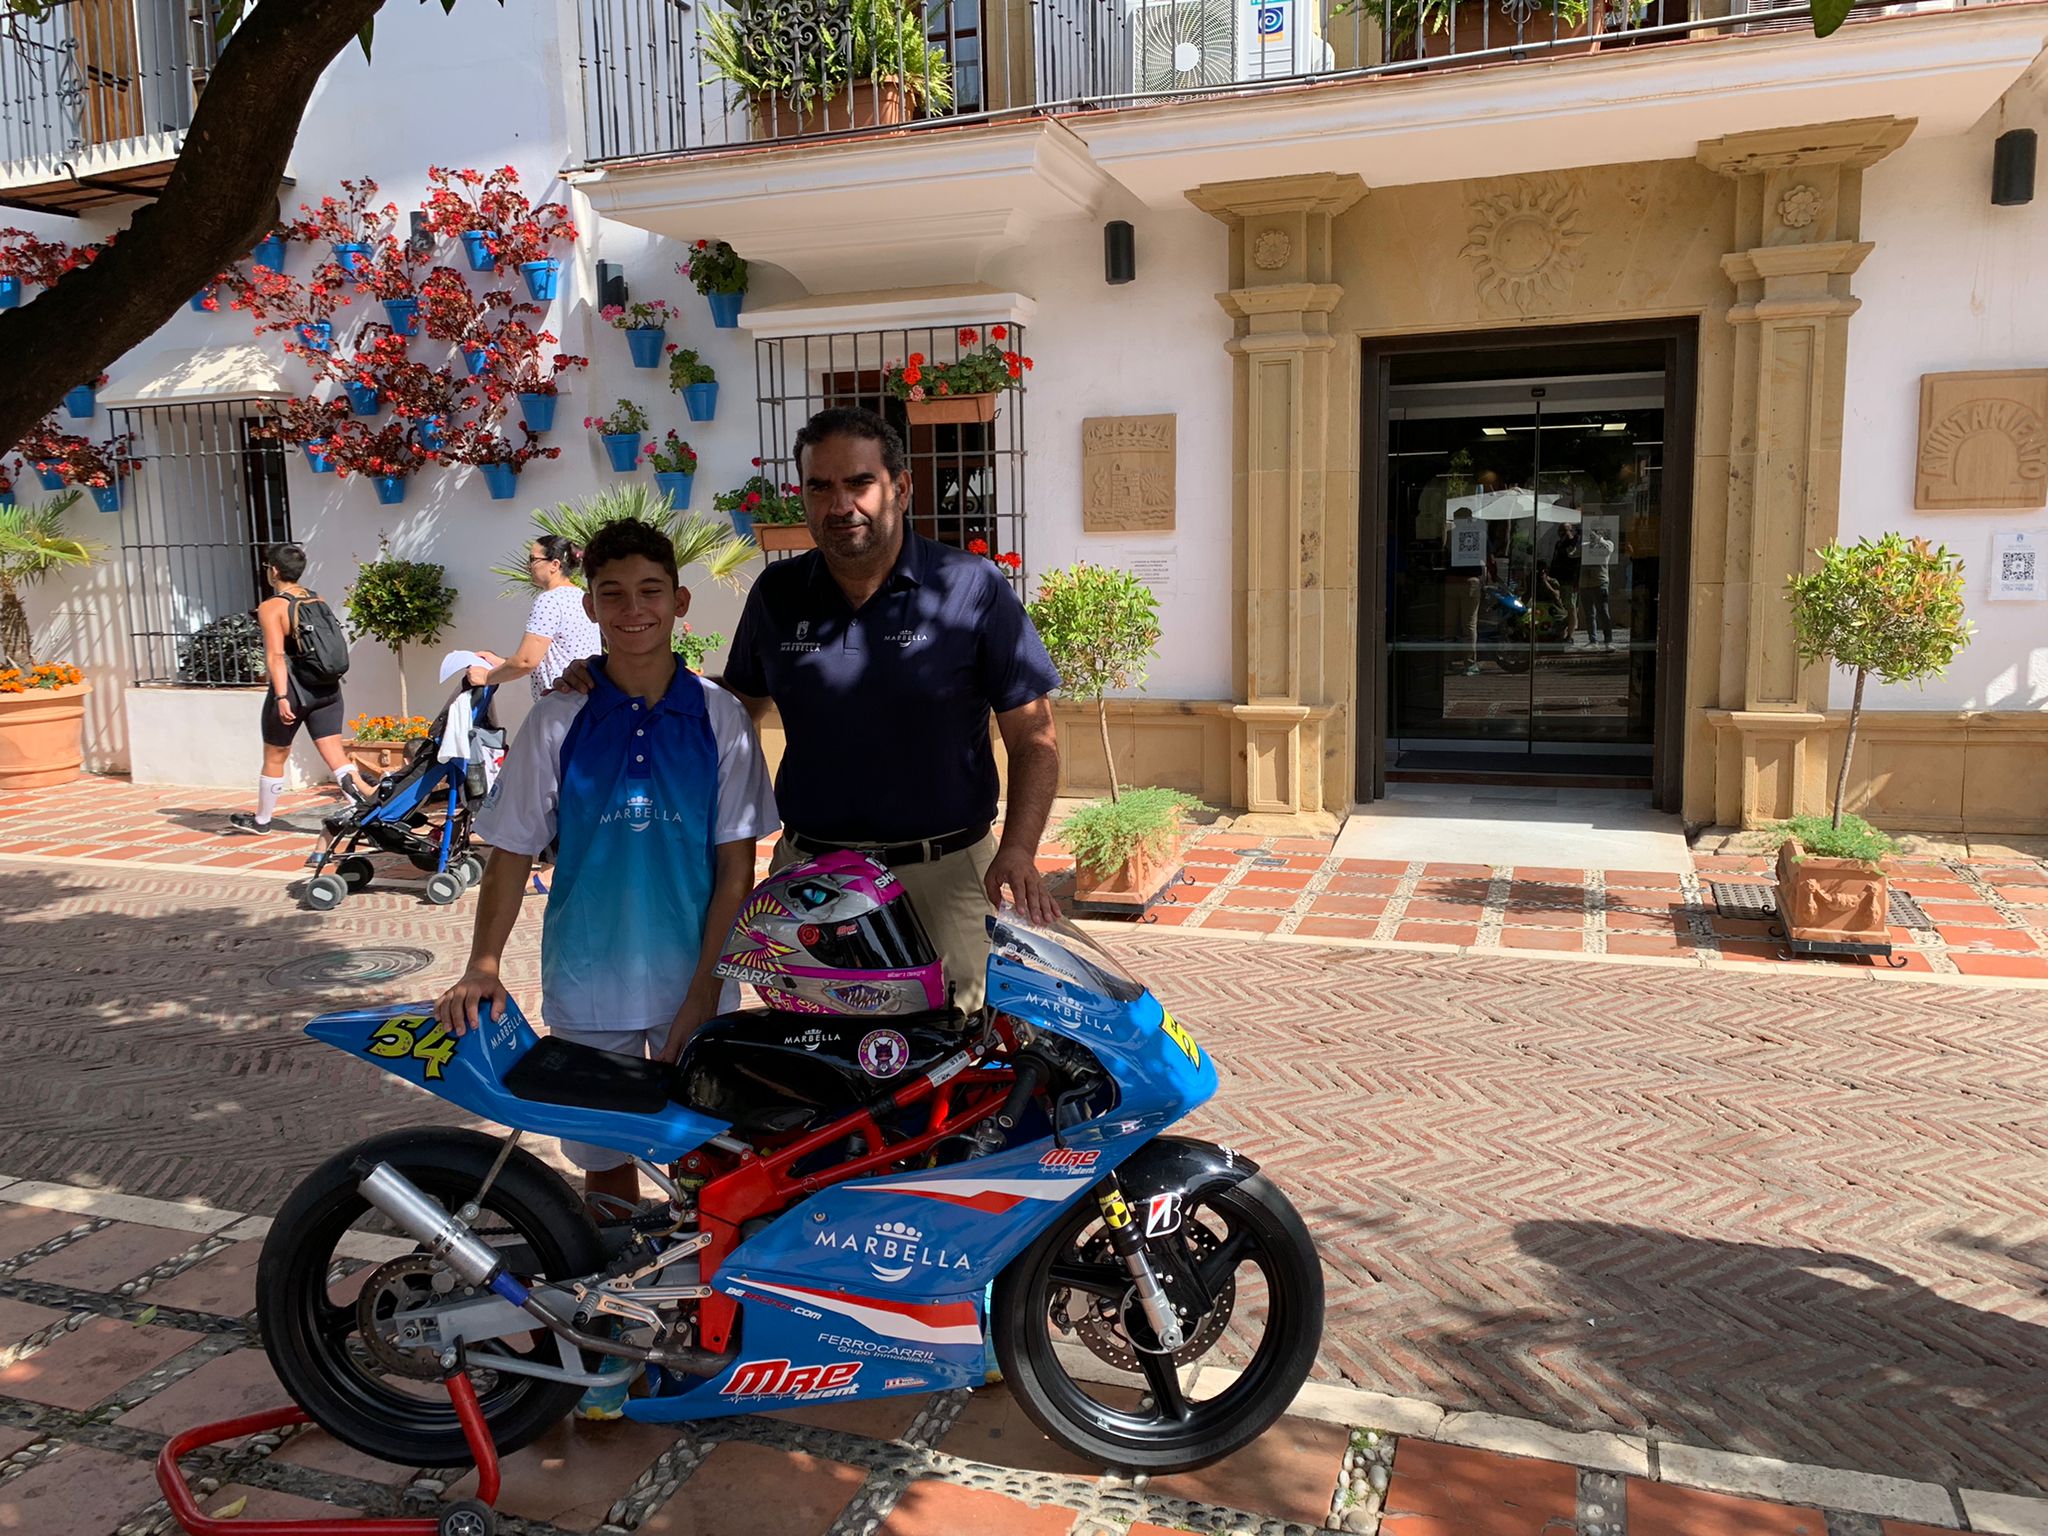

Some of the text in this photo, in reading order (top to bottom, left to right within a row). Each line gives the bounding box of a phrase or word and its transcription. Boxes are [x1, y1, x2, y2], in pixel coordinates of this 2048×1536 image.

[1922, 403, 2047, 479] AYUNTAMIENTO
[884, 634, 928, 642] MARBELLA
[599, 807, 683, 824] MARBELLA
[716, 963, 777, 986] SHARK
[1025, 992, 1113, 1034] MARBELLA
[489, 1014, 523, 1050] MARBELLA
[784, 1033, 842, 1045] MARBELLA
[368, 1012, 459, 1082] 54
[814, 1230, 971, 1270] MARBELLA
[817, 1332, 938, 1360] FERROCARRIL
[836, 1345, 935, 1364] Grupo Inmobiliario
[793, 1382, 860, 1401] Talent
